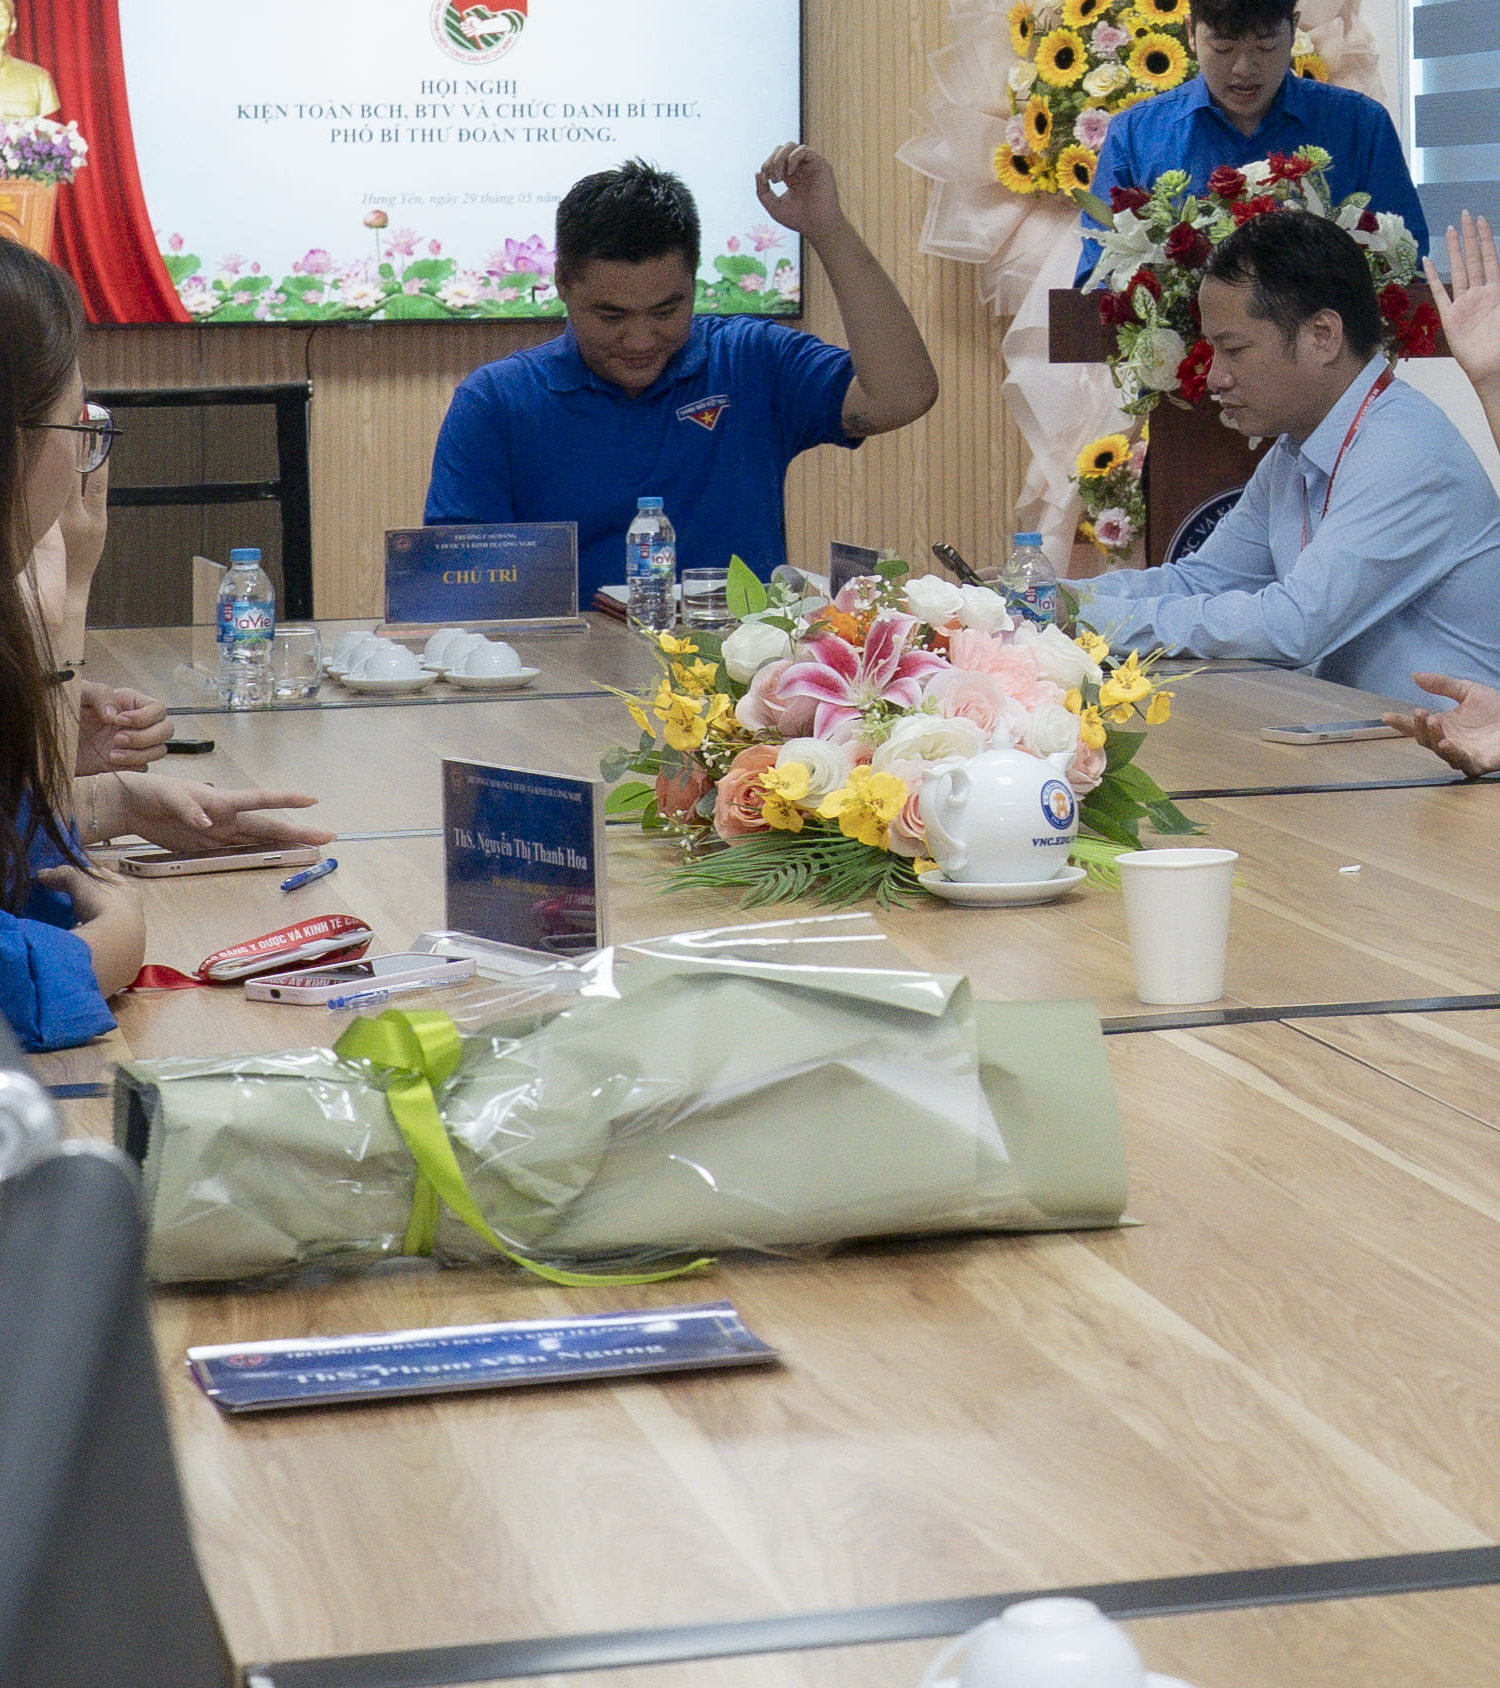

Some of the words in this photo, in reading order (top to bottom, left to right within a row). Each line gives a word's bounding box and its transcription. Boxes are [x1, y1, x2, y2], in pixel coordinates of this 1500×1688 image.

[421, 79, 458, 98] HỘI
[465, 79, 518, 99] NGHỊ
[237, 102, 288, 123] KIỆN
[296, 100, 352, 119] TOÀN
[360, 103, 409, 120] BCH,
[415, 103, 454, 119] BTV
[462, 99, 489, 118] VÀ
[496, 99, 556, 118] CHỨC
[562, 102, 619, 118] DANH
[627, 99, 646, 118] BÍ
[652, 100, 702, 119] THƯ,
[330, 124, 373, 143] PHÓ
[380, 123, 401, 143] BÍ
[406, 126, 452, 143] THƯ
[458, 124, 515, 142] ĐOÀN
[522, 123, 617, 143] TRƯỜNG.
[442, 566, 482, 585] CHỦ
[487, 564, 518, 583] TRÌ
[453, 828, 476, 849] ThS.
[532, 842, 565, 866] Thanh
[566, 848, 588, 871] Hoa
[302, 921, 329, 937] KINH
